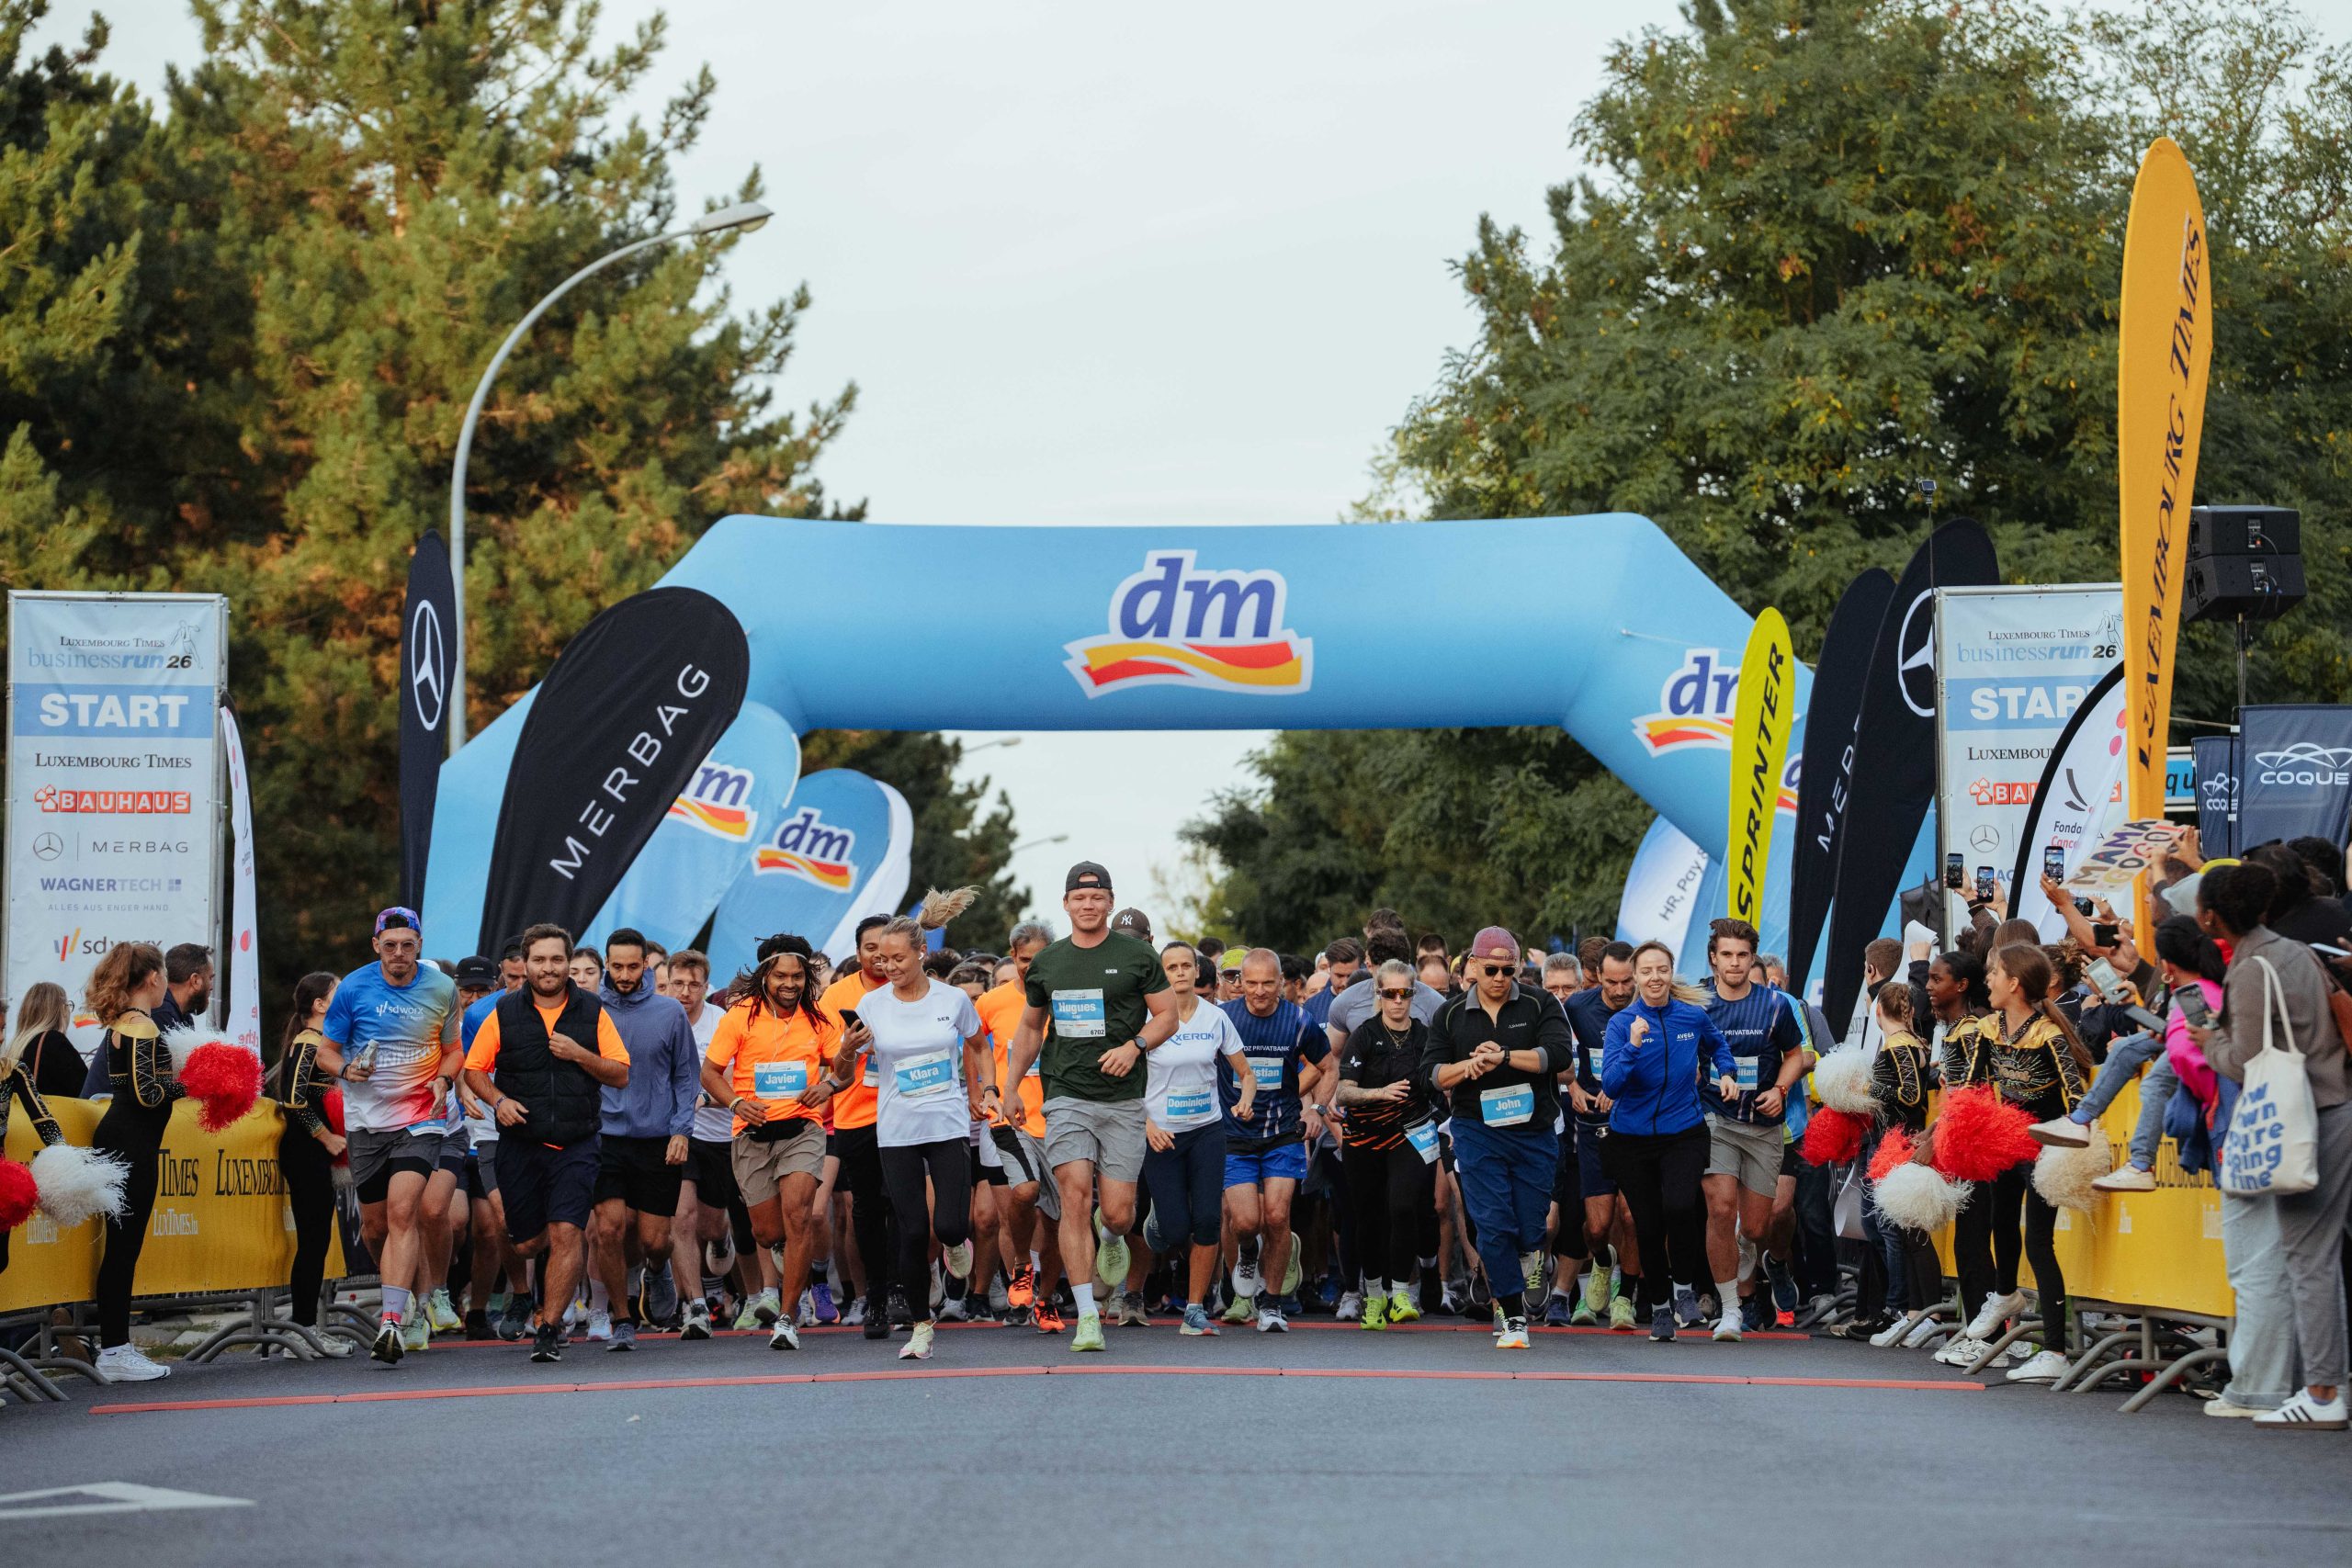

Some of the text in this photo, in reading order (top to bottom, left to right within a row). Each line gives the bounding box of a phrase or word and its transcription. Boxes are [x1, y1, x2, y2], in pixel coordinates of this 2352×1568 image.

[1120, 557, 1276, 638] dm
[2092, 645, 2118, 659] 26
[166, 655, 192, 669] 26
[40, 693, 189, 728] START
[1970, 685, 2096, 721] STAR
[35, 752, 192, 769] LUXEMBOURG TIMES
[1967, 747, 2054, 761] LUXEMBOU
[549, 663, 711, 880] MERBAG
[2259, 771, 2350, 786] COQUE
[682, 766, 748, 807] m
[1737, 641, 1784, 922] SPRINTER
[60, 792, 190, 812] BAUHAUS
[2206, 798, 2239, 811] COQE
[778, 812, 850, 862] dm
[92, 841, 188, 853] MERBAG
[40, 877, 162, 892] WAGNERTECH
[1677, 861, 1705, 893] Pay
[48, 903, 80, 912] ALLES
[84, 904, 103, 912] AUS
[1057, 1001, 1096, 1015] Hugues
[764, 1073, 797, 1085] Javier
[910, 1066, 939, 1081] Klara
[1252, 1067, 1280, 1077] istian
[1168, 1096, 1212, 1108] Dominique
[1495, 1099, 1521, 1111] John
[158, 1148, 199, 1197] TIMES
